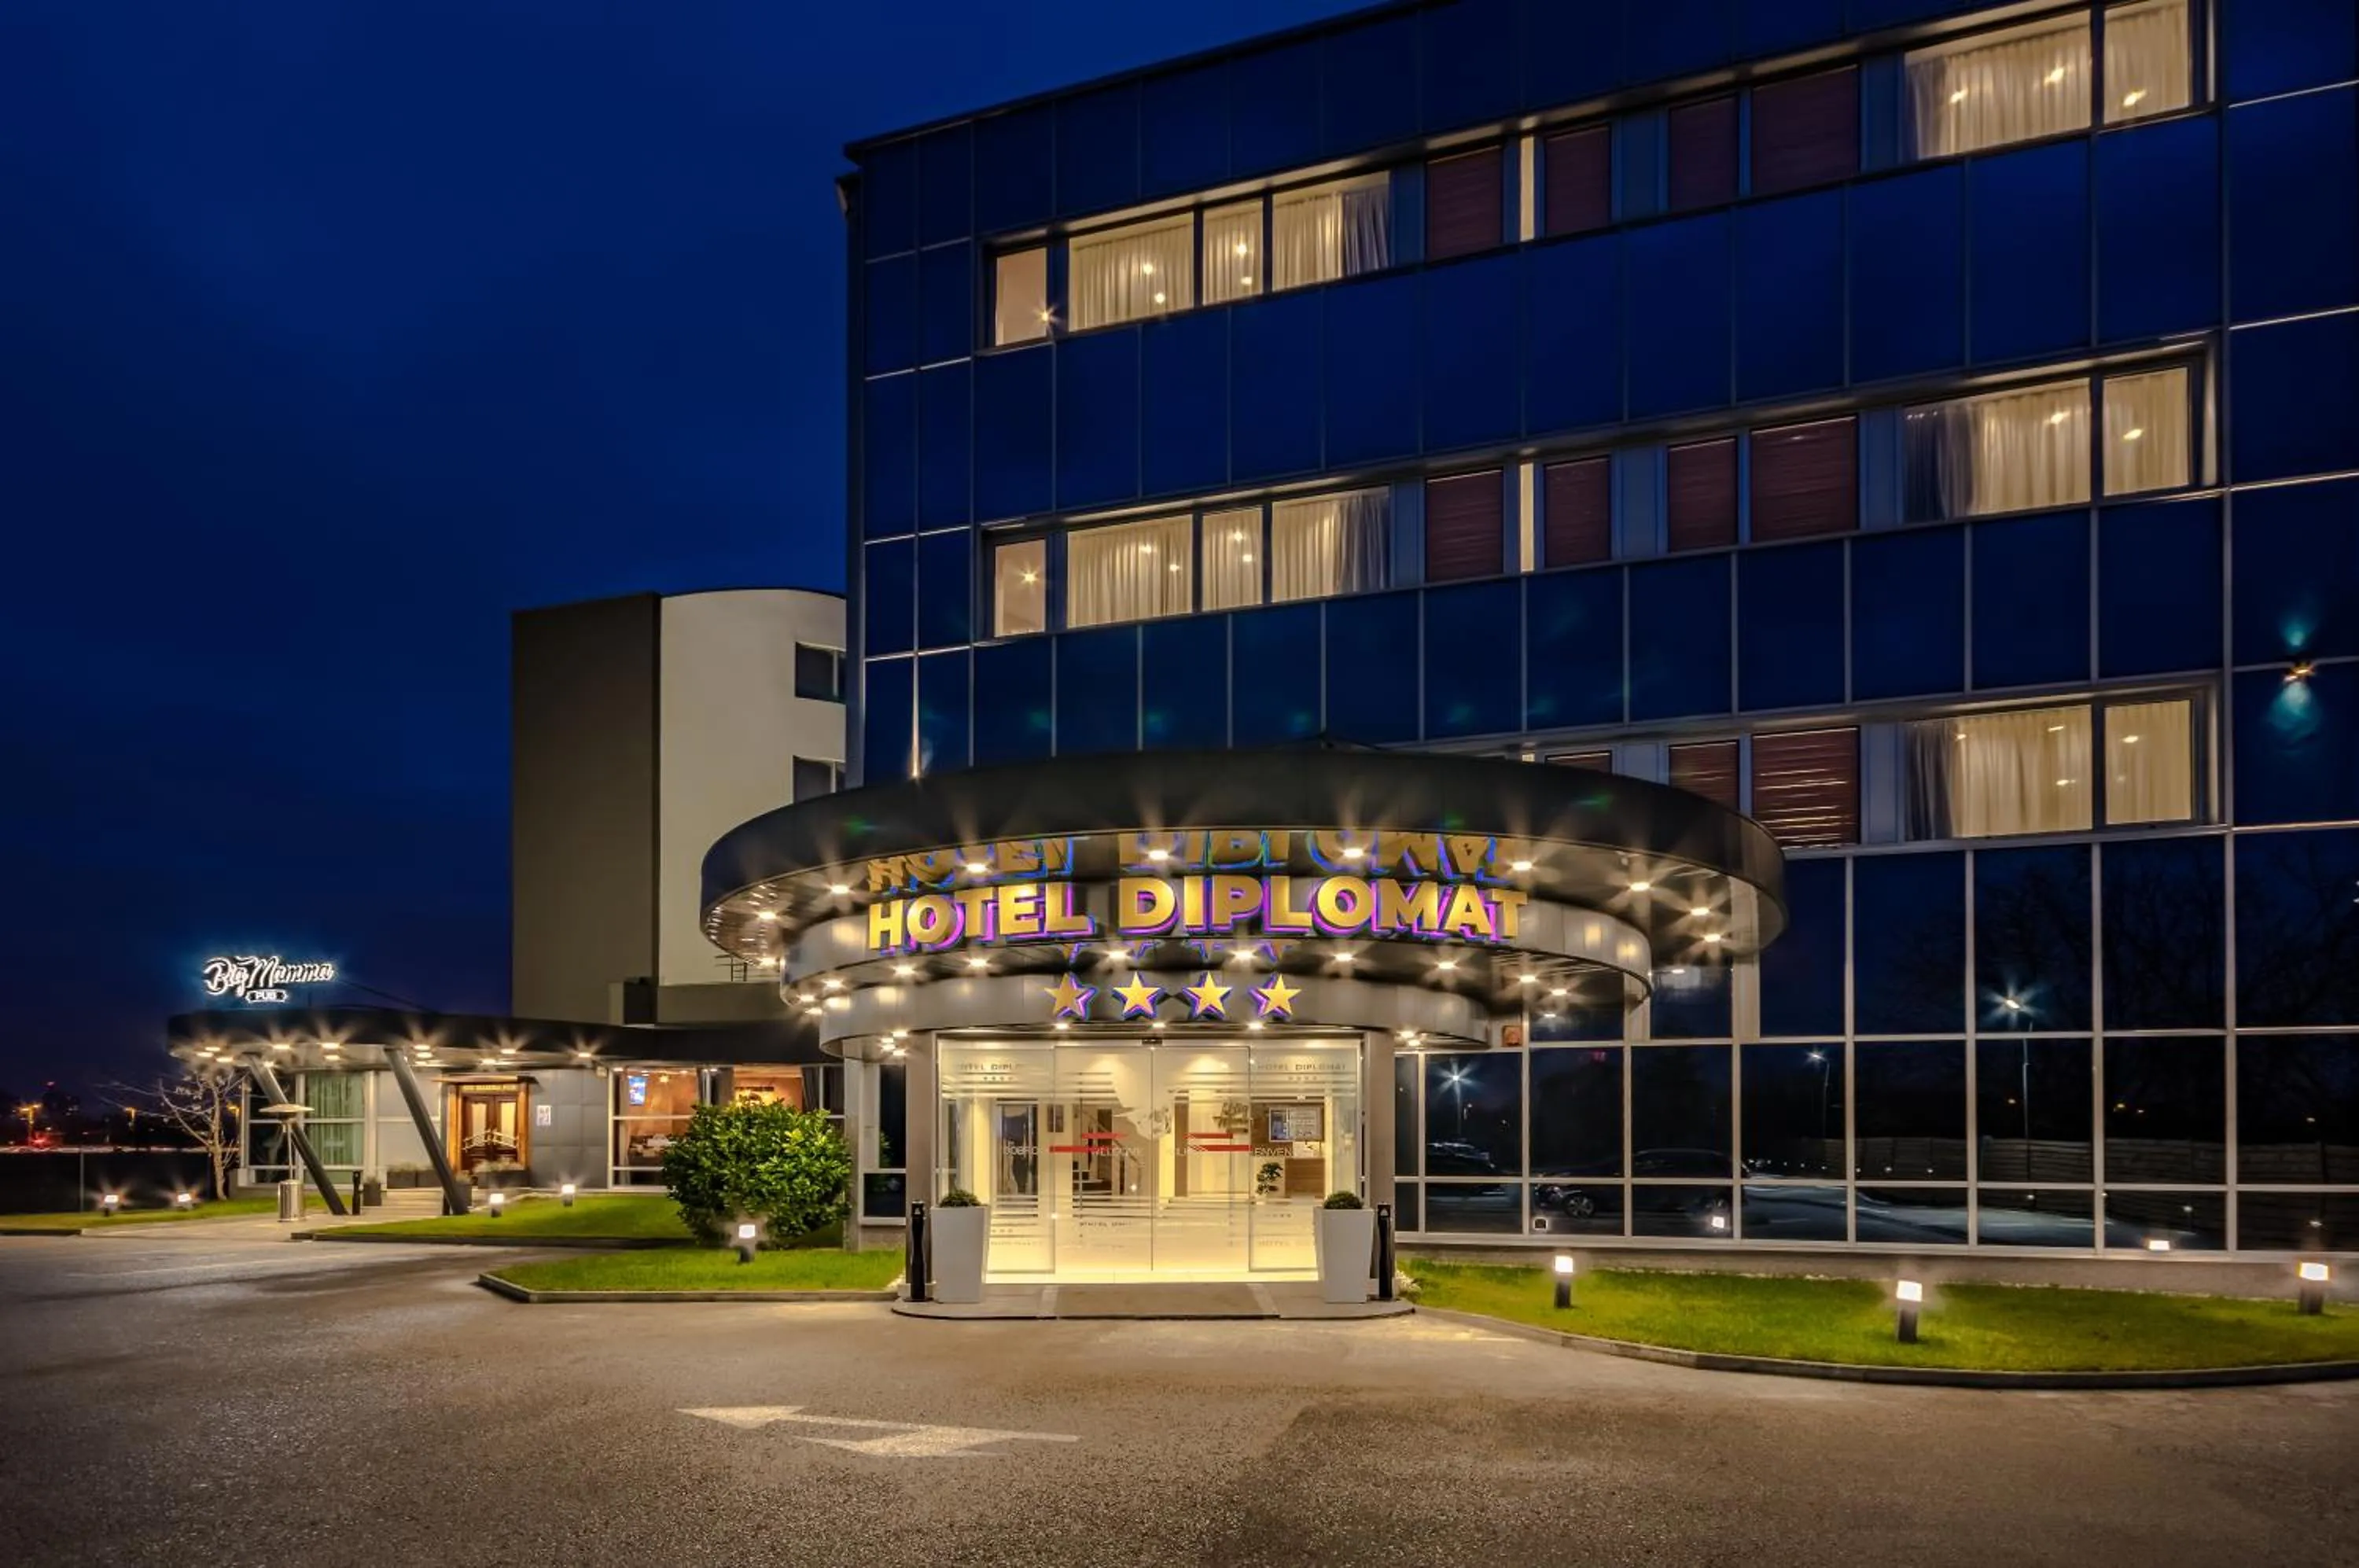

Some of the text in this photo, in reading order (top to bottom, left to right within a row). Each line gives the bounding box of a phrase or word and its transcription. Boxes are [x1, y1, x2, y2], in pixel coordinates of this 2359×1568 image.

[869, 875, 1527, 953] HOTEL DIPLOMAT
[203, 955, 335, 997] Big Mamma
